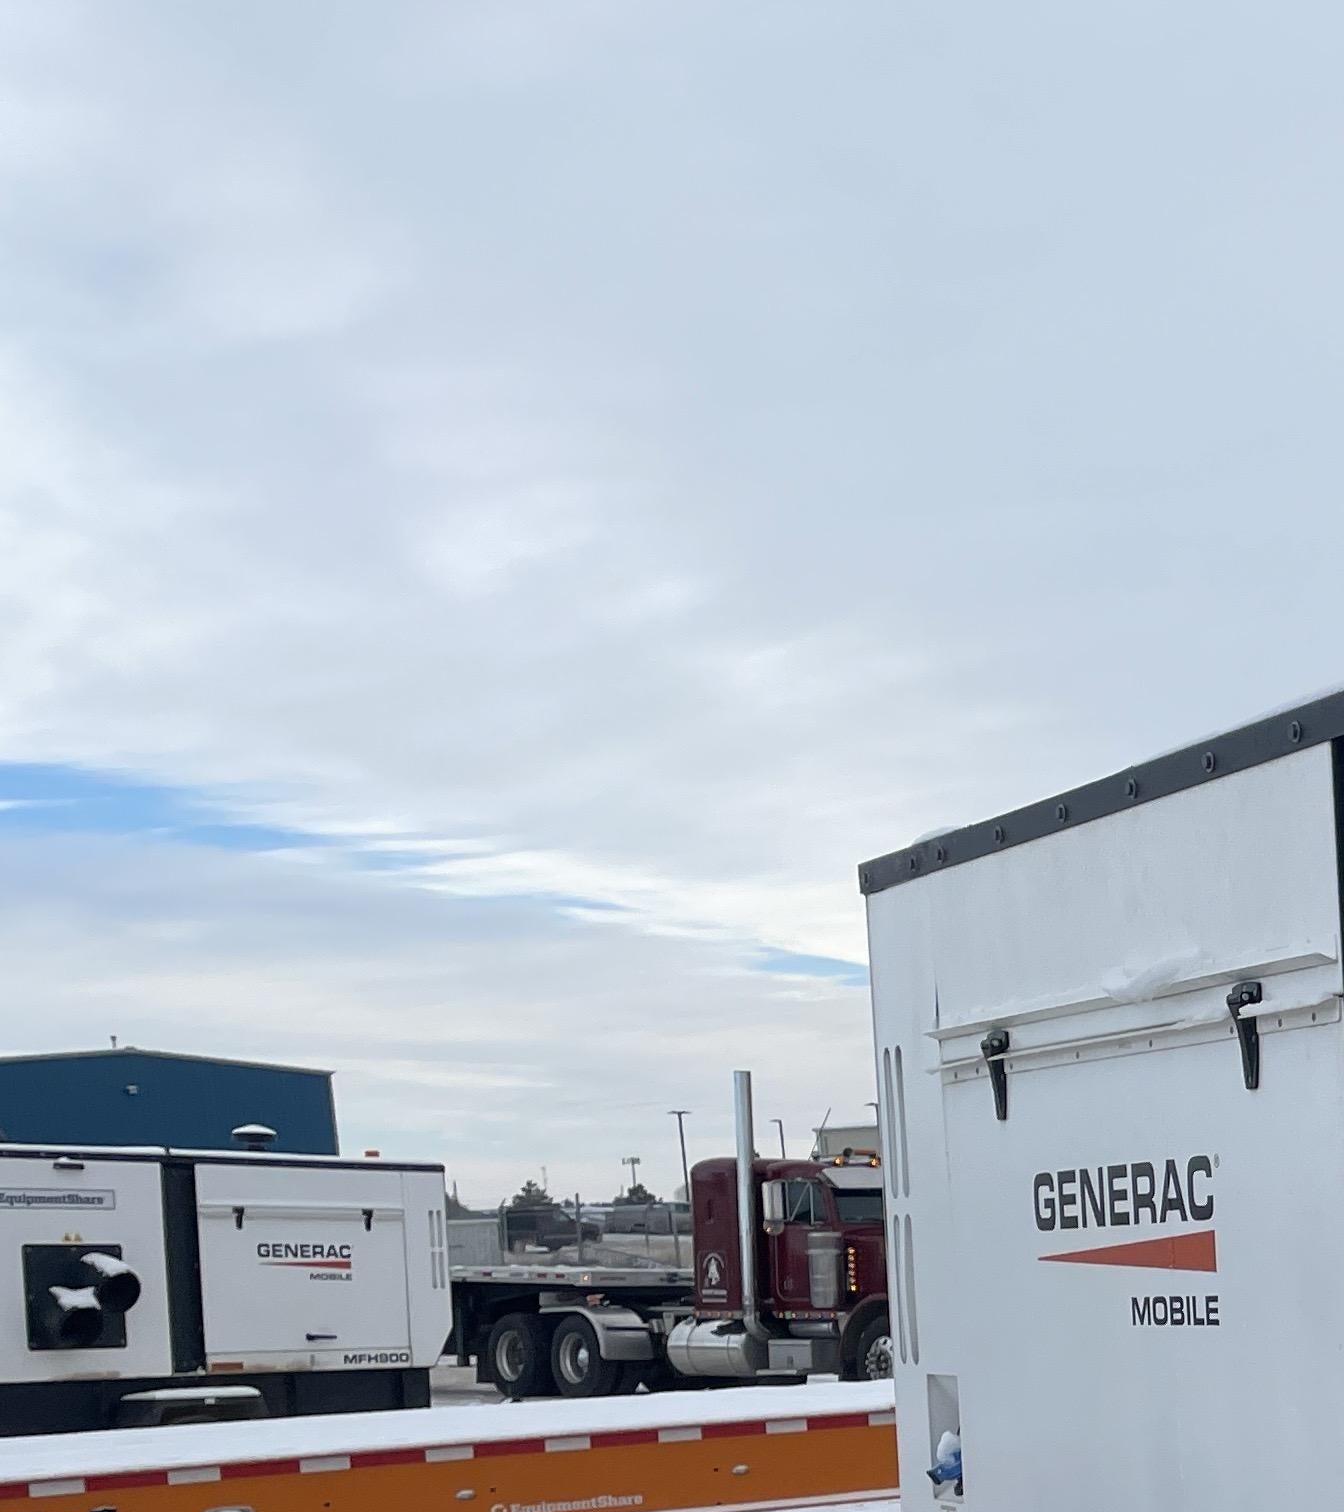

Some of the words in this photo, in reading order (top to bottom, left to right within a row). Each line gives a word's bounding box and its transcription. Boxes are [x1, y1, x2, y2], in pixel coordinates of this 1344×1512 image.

[1033, 1154, 1215, 1232] GENERAC
[257, 1242, 352, 1259] GENERAC
[1130, 1295, 1220, 1327] MOBILE
